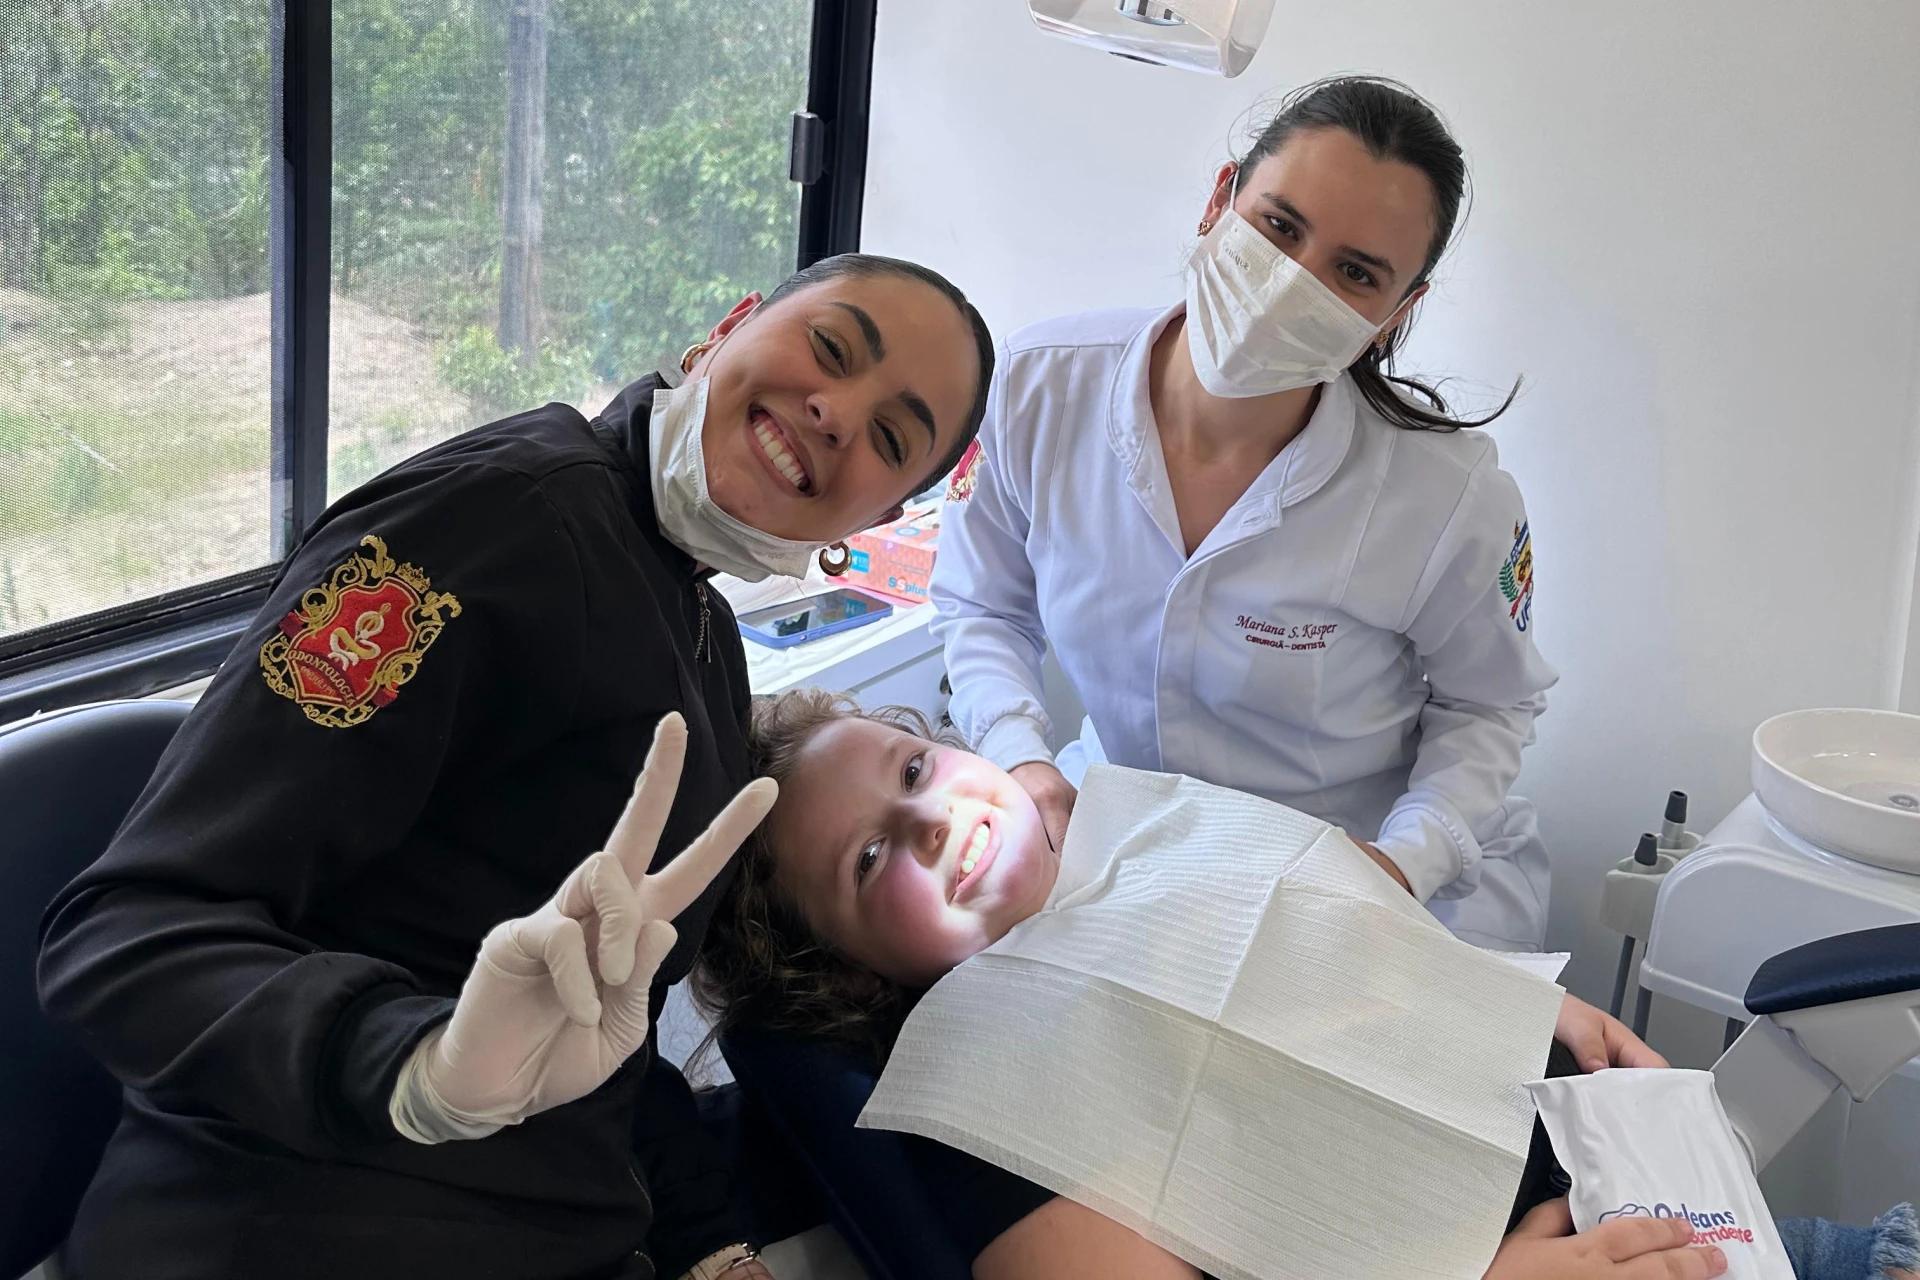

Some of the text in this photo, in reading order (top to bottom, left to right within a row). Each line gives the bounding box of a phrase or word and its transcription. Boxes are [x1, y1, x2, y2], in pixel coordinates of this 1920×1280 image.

[1235, 615, 1338, 641] Mariana S. Kasper
[288, 650, 356, 708] ODONTOLOGIA
[1654, 1203, 1736, 1229] Orleans
